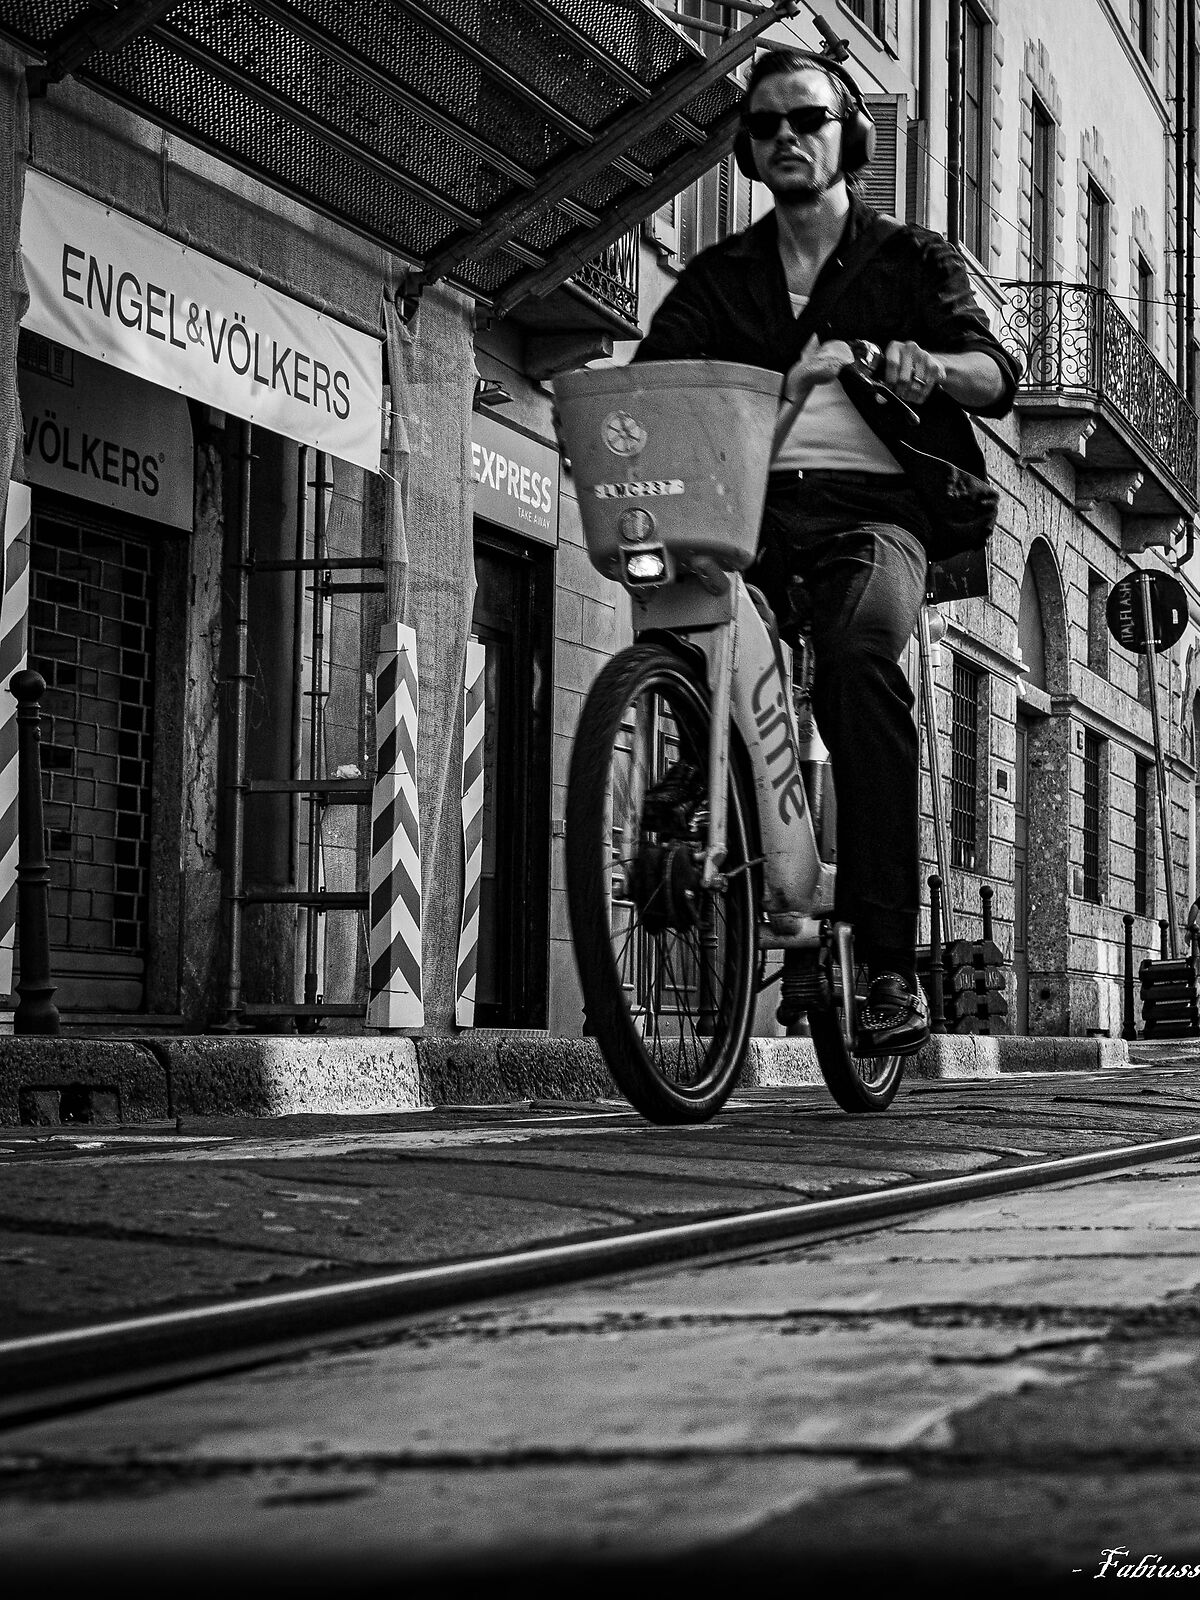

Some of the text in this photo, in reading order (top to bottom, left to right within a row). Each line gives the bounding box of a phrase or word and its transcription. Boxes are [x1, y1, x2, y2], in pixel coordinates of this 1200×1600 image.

[471, 442, 552, 513] EXPRESS
[518, 507, 551, 530] TAKE AWAY
[1119, 582, 1135, 643] ITALFLASH
